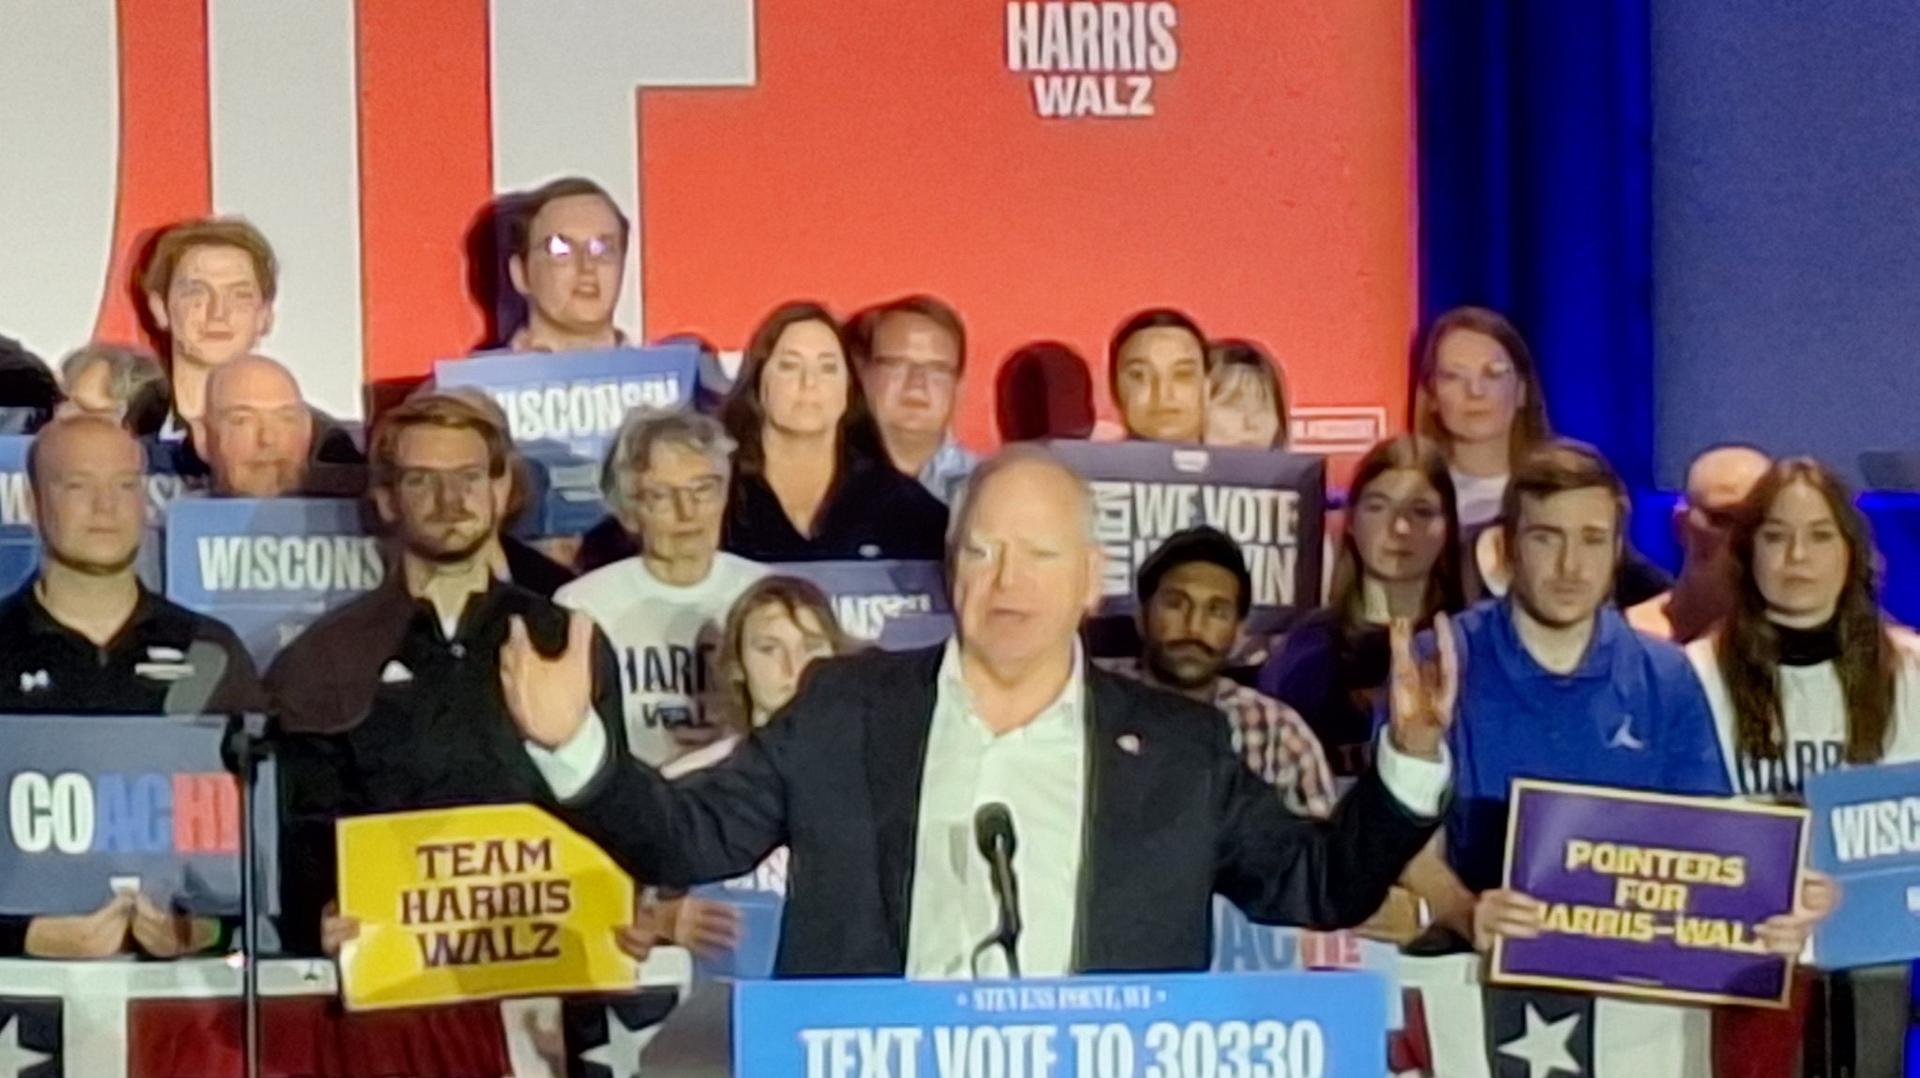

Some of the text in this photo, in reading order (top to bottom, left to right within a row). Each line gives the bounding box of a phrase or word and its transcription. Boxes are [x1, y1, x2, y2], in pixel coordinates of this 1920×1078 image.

[1006, 2, 1177, 71] HARRIS
[1033, 75, 1154, 117] WALZ
[1134, 482, 1301, 544] WE VOTE
[1241, 543, 1299, 606] IN
[416, 838, 552, 879] TEAM
[1566, 838, 1745, 887] POINTERS
[401, 879, 571, 925] HARRIS
[1615, 877, 1688, 911] FOR
[416, 922, 561, 967] WALZ
[1537, 901, 1767, 955] ARRIS-WAL
[802, 1020, 1325, 1078] TEXT VOTE TO 30330
